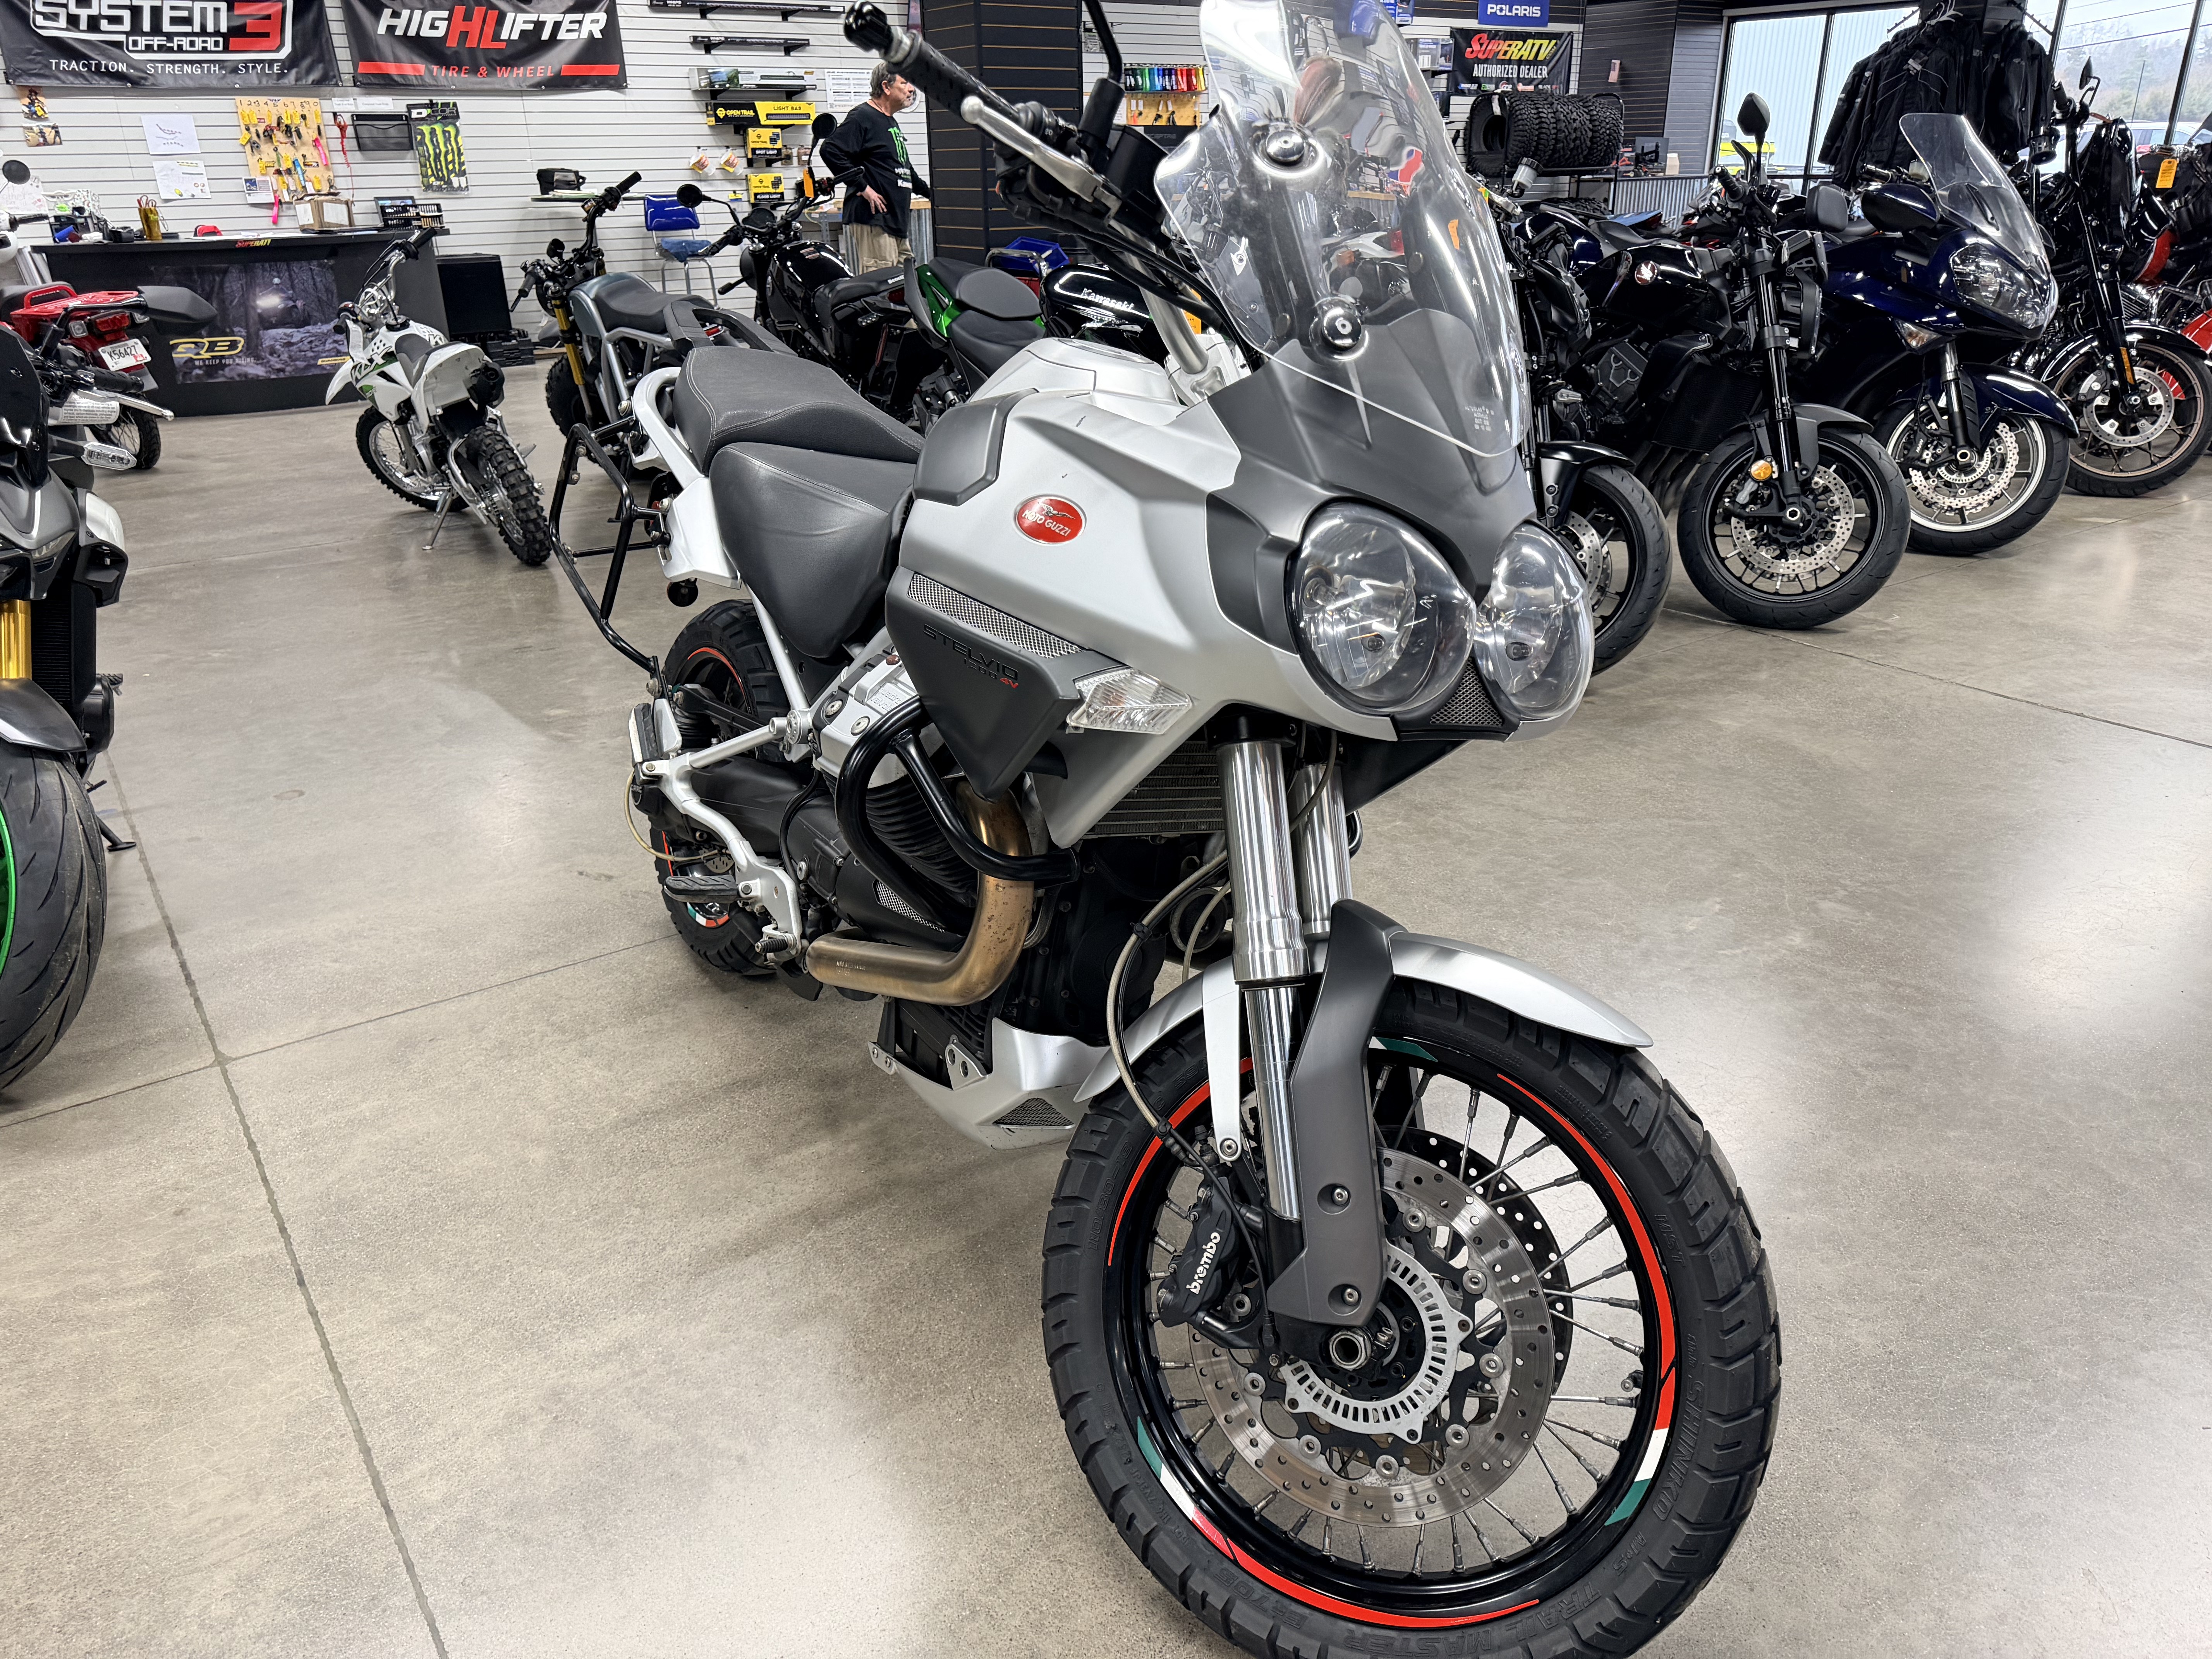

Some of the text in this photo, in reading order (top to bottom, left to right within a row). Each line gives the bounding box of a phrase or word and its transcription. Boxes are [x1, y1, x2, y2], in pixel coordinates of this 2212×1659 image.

[1487, 4, 1541, 17] POLARIS
[34, 0, 283, 51] SYSTEM 3
[377, 5, 607, 49] HIGHLIFTER
[129, 36, 223, 51] OFF-ROAD
[1465, 33, 1557, 60] SUPERATV
[49, 59, 289, 75] TRACTION. STRENGTH. STYLE.
[431, 65, 555, 78] TIRE & WHEEL
[1472, 64, 1548, 78] AUTHORIZED DEALER
[1081, 288, 1134, 312] Kawasaki
[107, 345, 138, 361] K56427
[350, 346, 392, 386] KLX
[1022, 509, 1071, 537] MOTO GUZZI
[923, 623, 1018, 681] STELVIO
[1000, 677, 1019, 689] 4V
[1186, 1231, 1221, 1295] brembo
[1652, 1375, 1705, 1521] SHINKO
[1344, 1580, 1602, 1659] TRAIL MASTER
